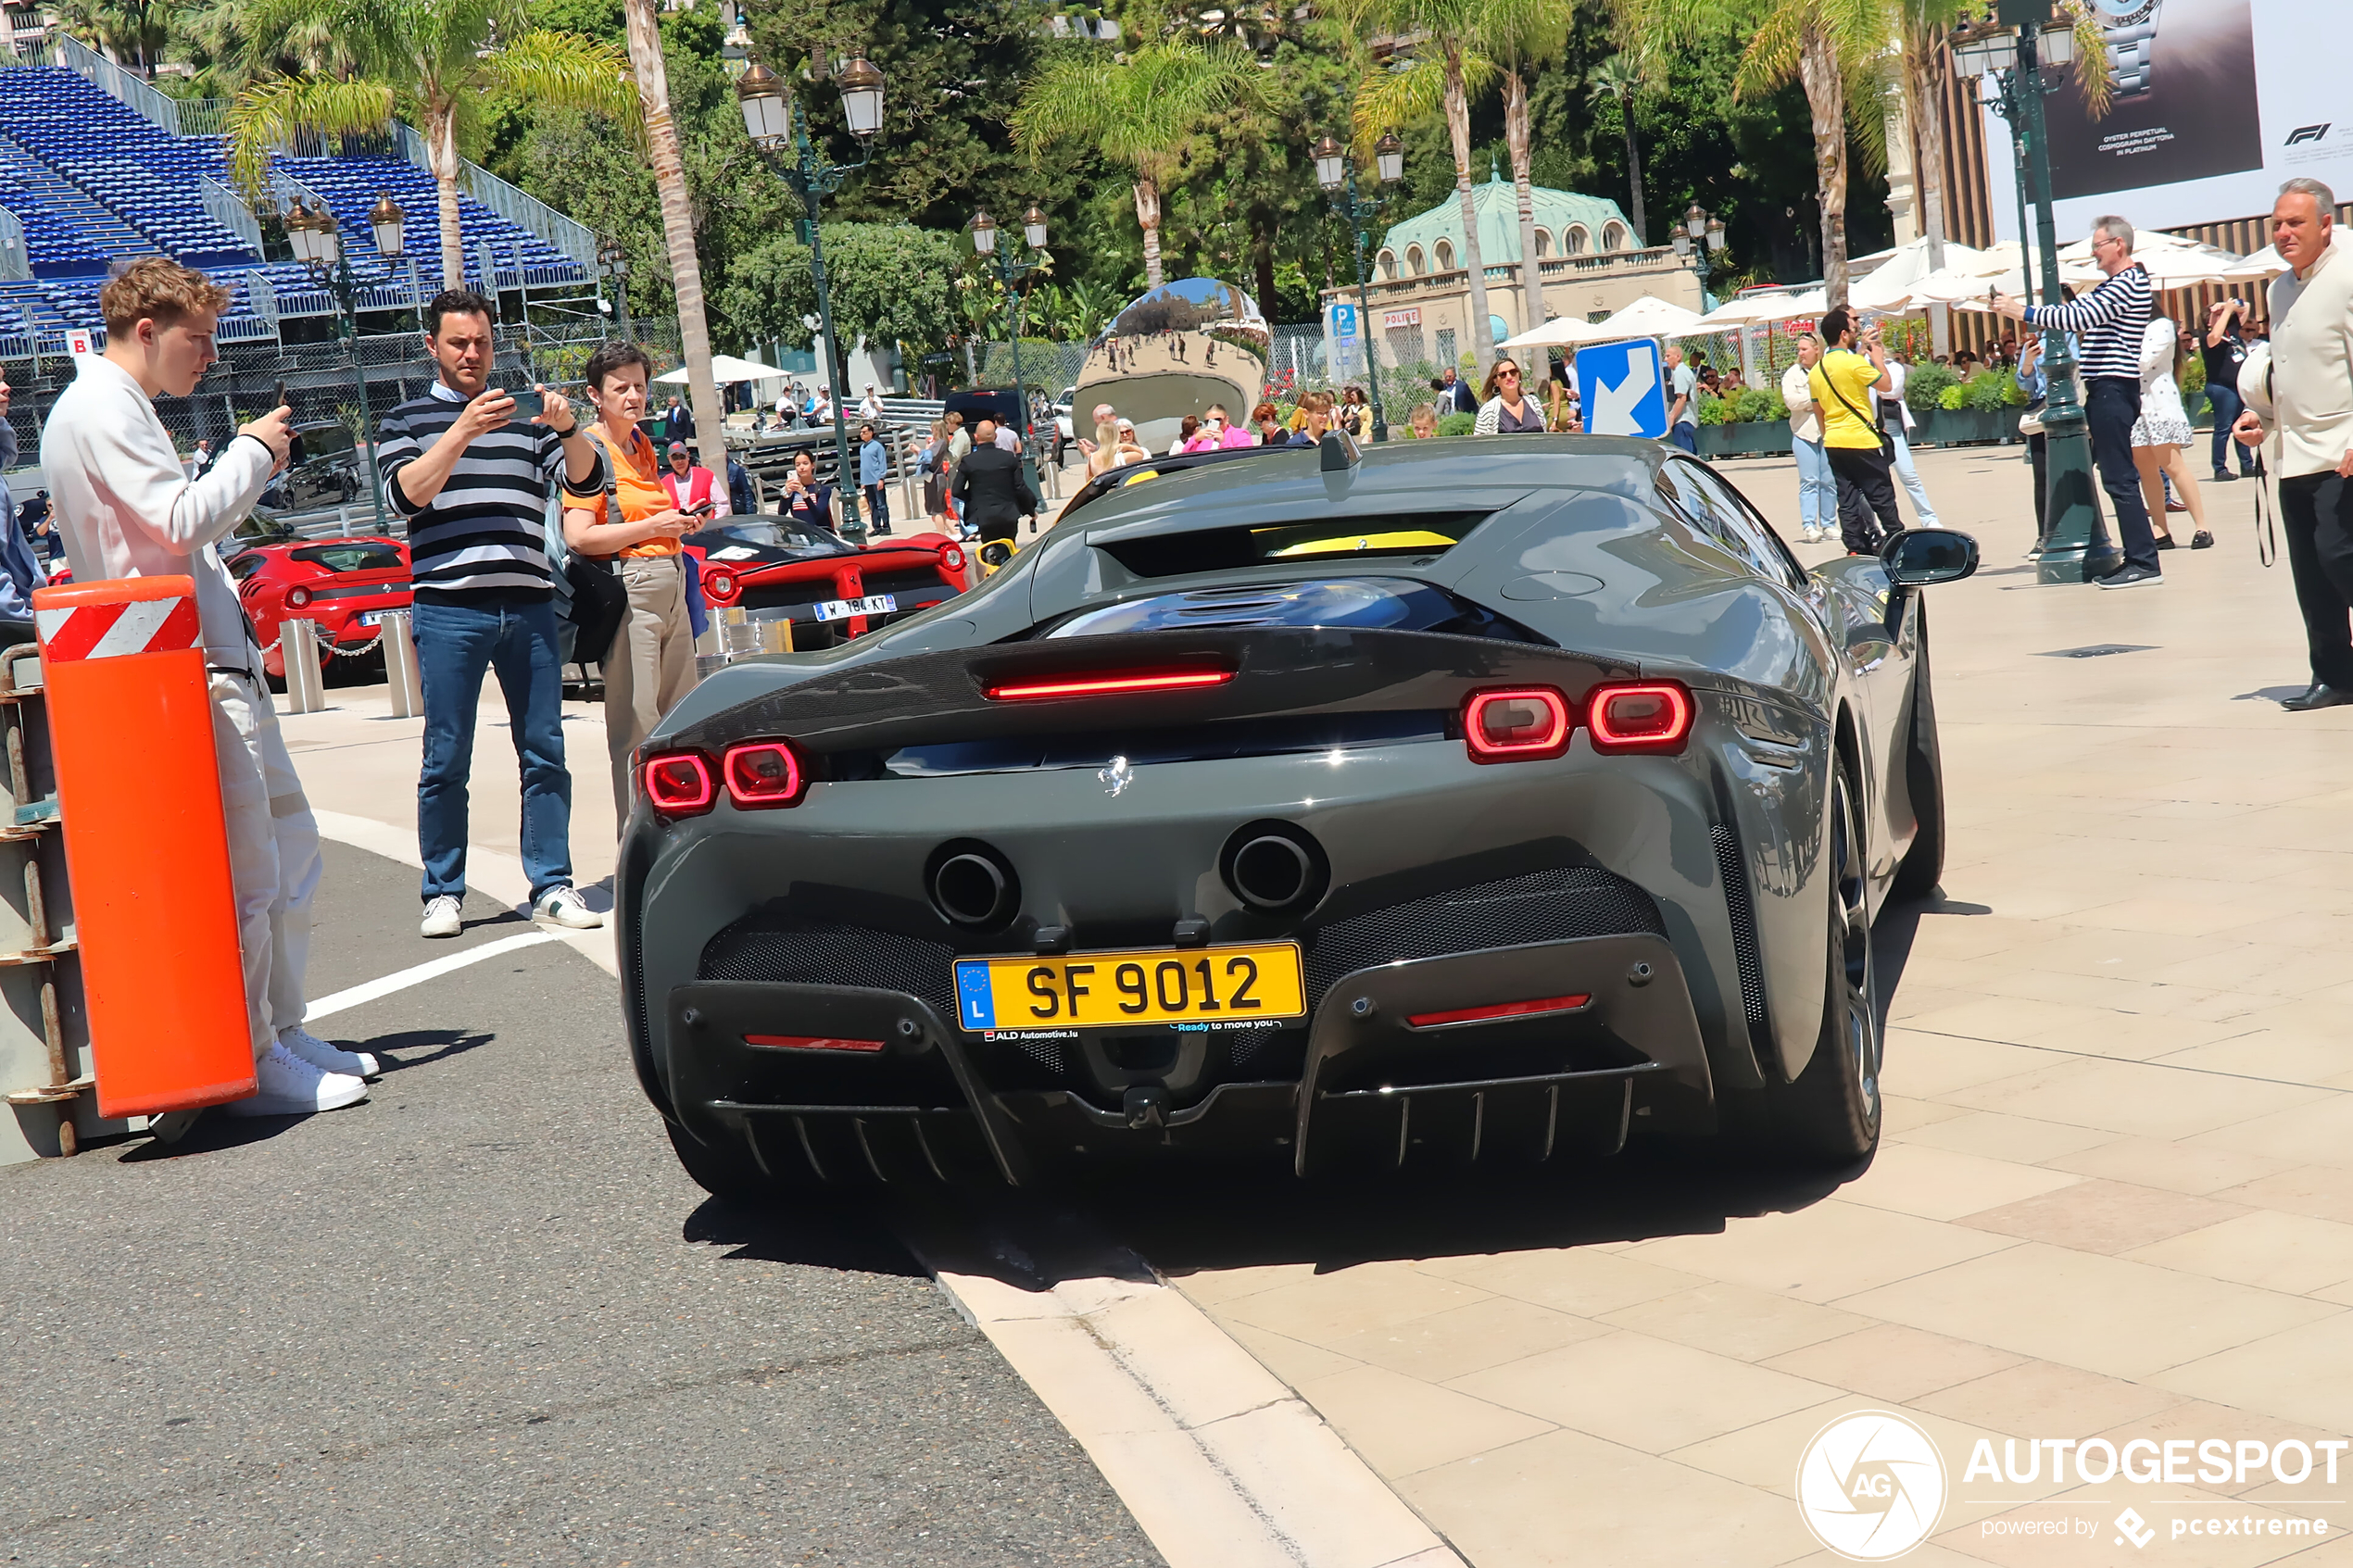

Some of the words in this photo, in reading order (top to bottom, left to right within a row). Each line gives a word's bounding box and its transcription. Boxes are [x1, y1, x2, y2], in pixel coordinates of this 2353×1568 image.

[2098, 139, 2143, 151] COSMOGRAPH
[2144, 133, 2174, 144] DAYTONA
[2103, 133, 2129, 143] OYSTER
[2130, 127, 2167, 137] PERPETUAL
[2284, 122, 2333, 146] F1
[2124, 144, 2157, 154] PLATINUM
[1337, 307, 1348, 325] P
[74, 340, 86, 353] B
[707, 546, 761, 560] 16
[1026, 964, 1096, 1018] SF
[1115, 957, 1262, 1014] 9012
[972, 1000, 985, 1018] L
[1177, 1022, 1210, 1033] Ready
[1211, 1022, 1223, 1030] to
[1224, 1021, 1252, 1030] move
[1253, 1020, 1274, 1029] you
[996, 1032, 1018, 1041] ALD
[1020, 1030, 1079, 1040] Automotive.lu
